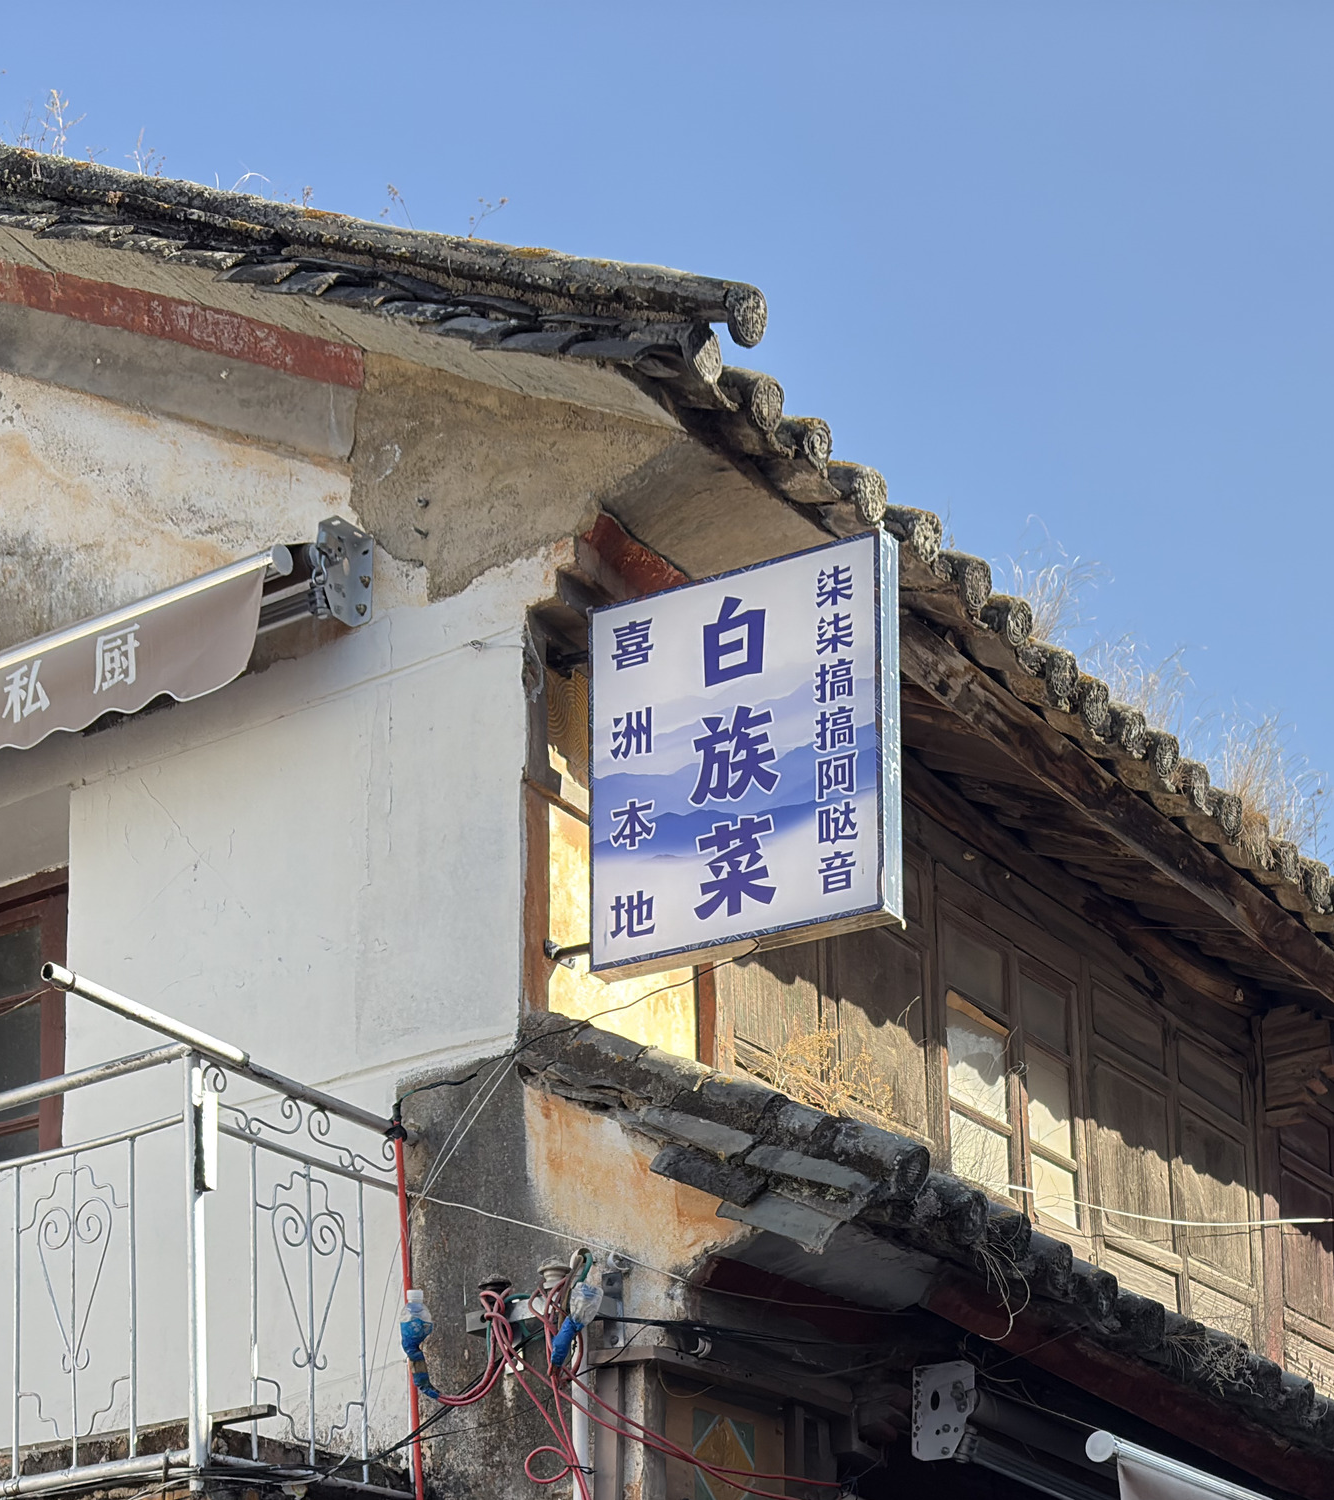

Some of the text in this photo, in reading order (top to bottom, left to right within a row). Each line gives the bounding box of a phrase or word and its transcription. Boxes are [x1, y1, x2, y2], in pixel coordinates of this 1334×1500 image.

[610, 617, 656, 939] 喜洲本地
[690, 596, 779, 921] 白族菜
[813, 566, 858, 895] 柒柒搞搞阿哒音
